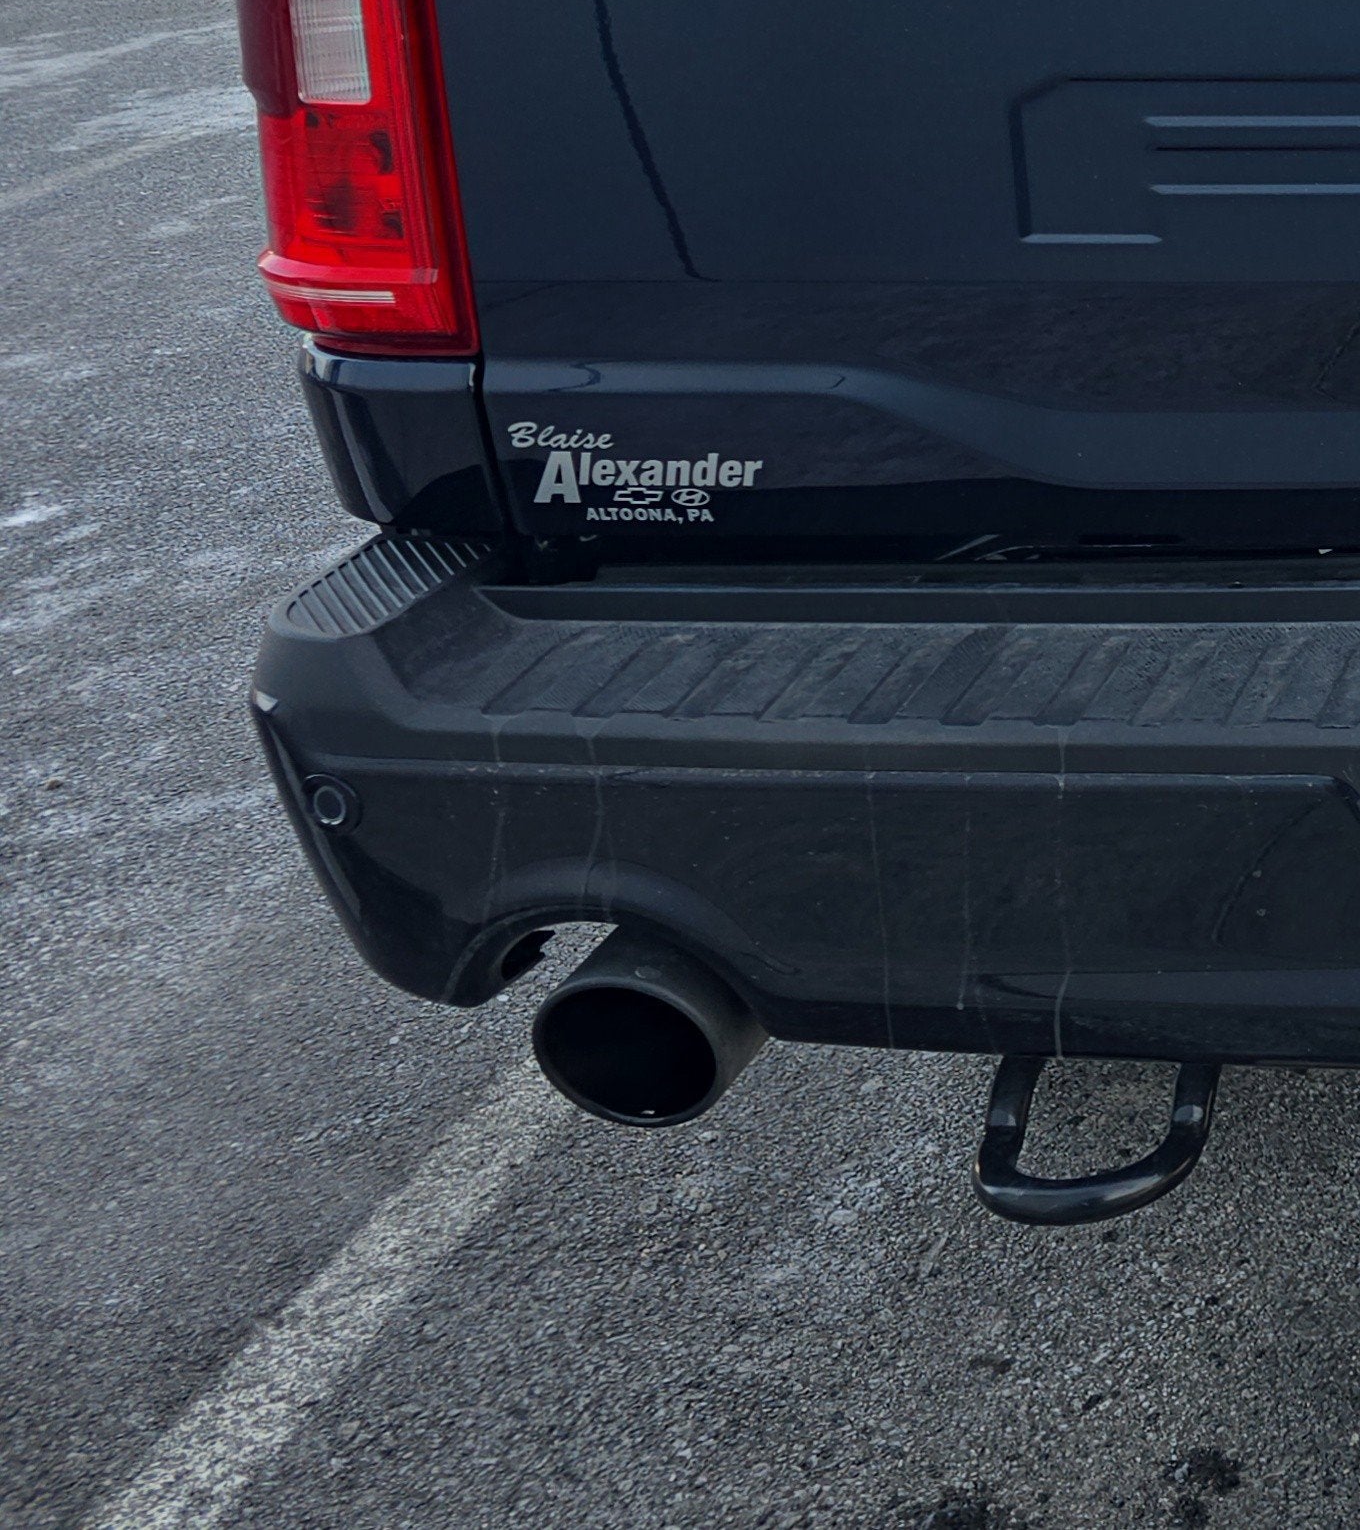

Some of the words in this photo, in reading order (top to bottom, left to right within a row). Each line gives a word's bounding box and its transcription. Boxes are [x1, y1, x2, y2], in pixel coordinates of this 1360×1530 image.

[507, 421, 614, 450] Blaise
[533, 451, 763, 504] Alexander
[586, 507, 684, 525] ALTOONA,
[687, 508, 714, 523] PA
